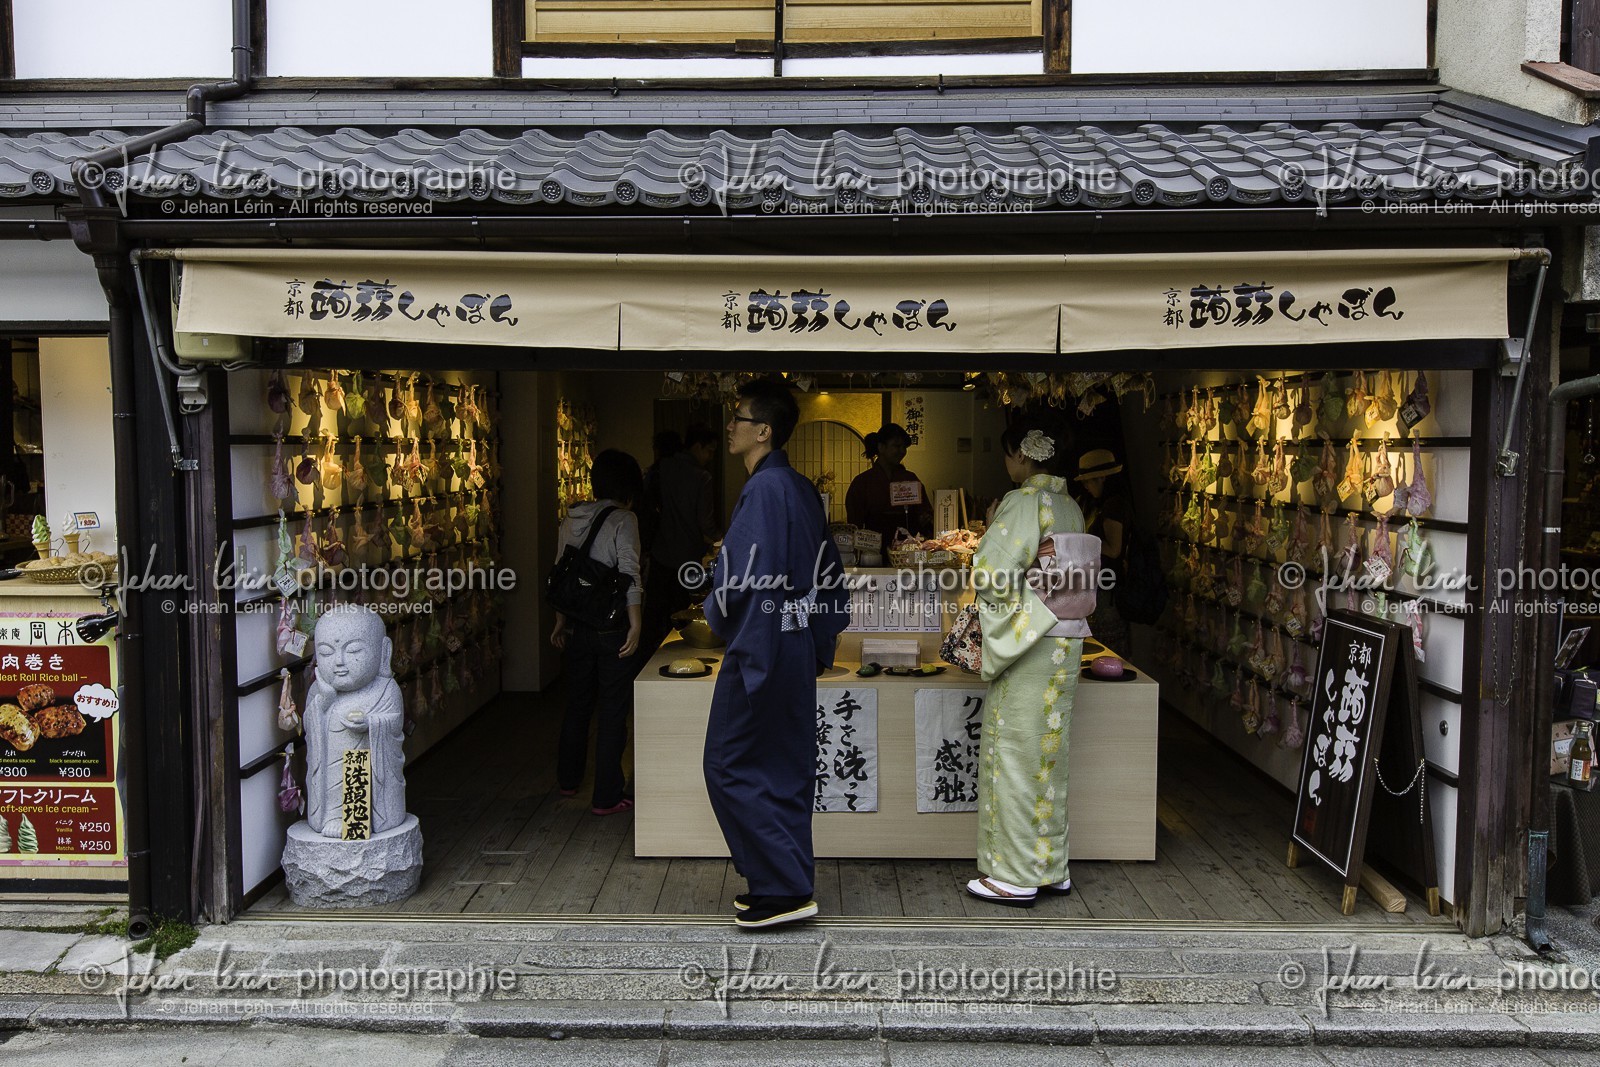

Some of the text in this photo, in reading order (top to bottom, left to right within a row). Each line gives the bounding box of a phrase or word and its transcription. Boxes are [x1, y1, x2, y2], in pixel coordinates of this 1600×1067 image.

[283, 278, 306, 320] 京都
[720, 289, 742, 332] 京都
[1162, 287, 1184, 329] 京都
[2, 653, 64, 670] 肉巻き
[1348, 640, 1372, 669] 京都
[0, 673, 17, 682] eat
[20, 673, 37, 682] Roll
[40, 673, 59, 682] Rice
[62, 673, 78, 682] ball
[76, 694, 117, 709] おすすめ!!
[344, 751, 368, 766] 京都
[833, 690, 868, 811] 手を洗って
[59, 767, 91, 778] ¥300
[932, 739, 966, 804] 感触
[0, 789, 97, 804] フトクリーム
[79, 822, 111, 833] ¥250
[79, 841, 112, 851] ¥250
